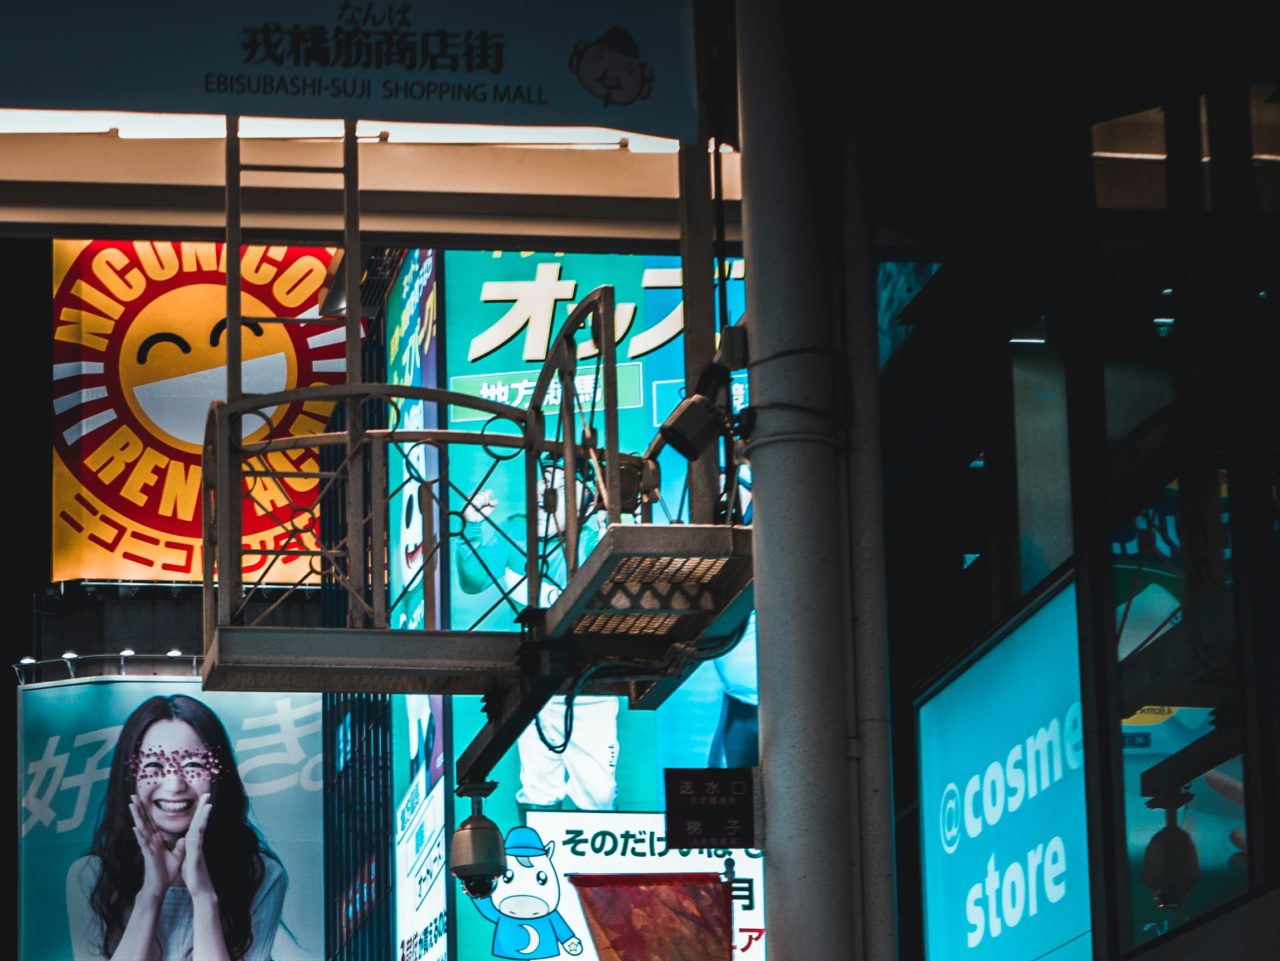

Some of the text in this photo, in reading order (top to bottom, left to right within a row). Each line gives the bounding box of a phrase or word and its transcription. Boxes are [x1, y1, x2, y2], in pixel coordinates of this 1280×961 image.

[336, 1, 412, 28] なんば
[240, 22, 505, 74] 戎橋筋商店街
[205, 73, 548, 105] EBISUBASHI-SUJI SHOPPING MALL
[939, 701, 1086, 855] @cosme
[966, 834, 1067, 949] store
